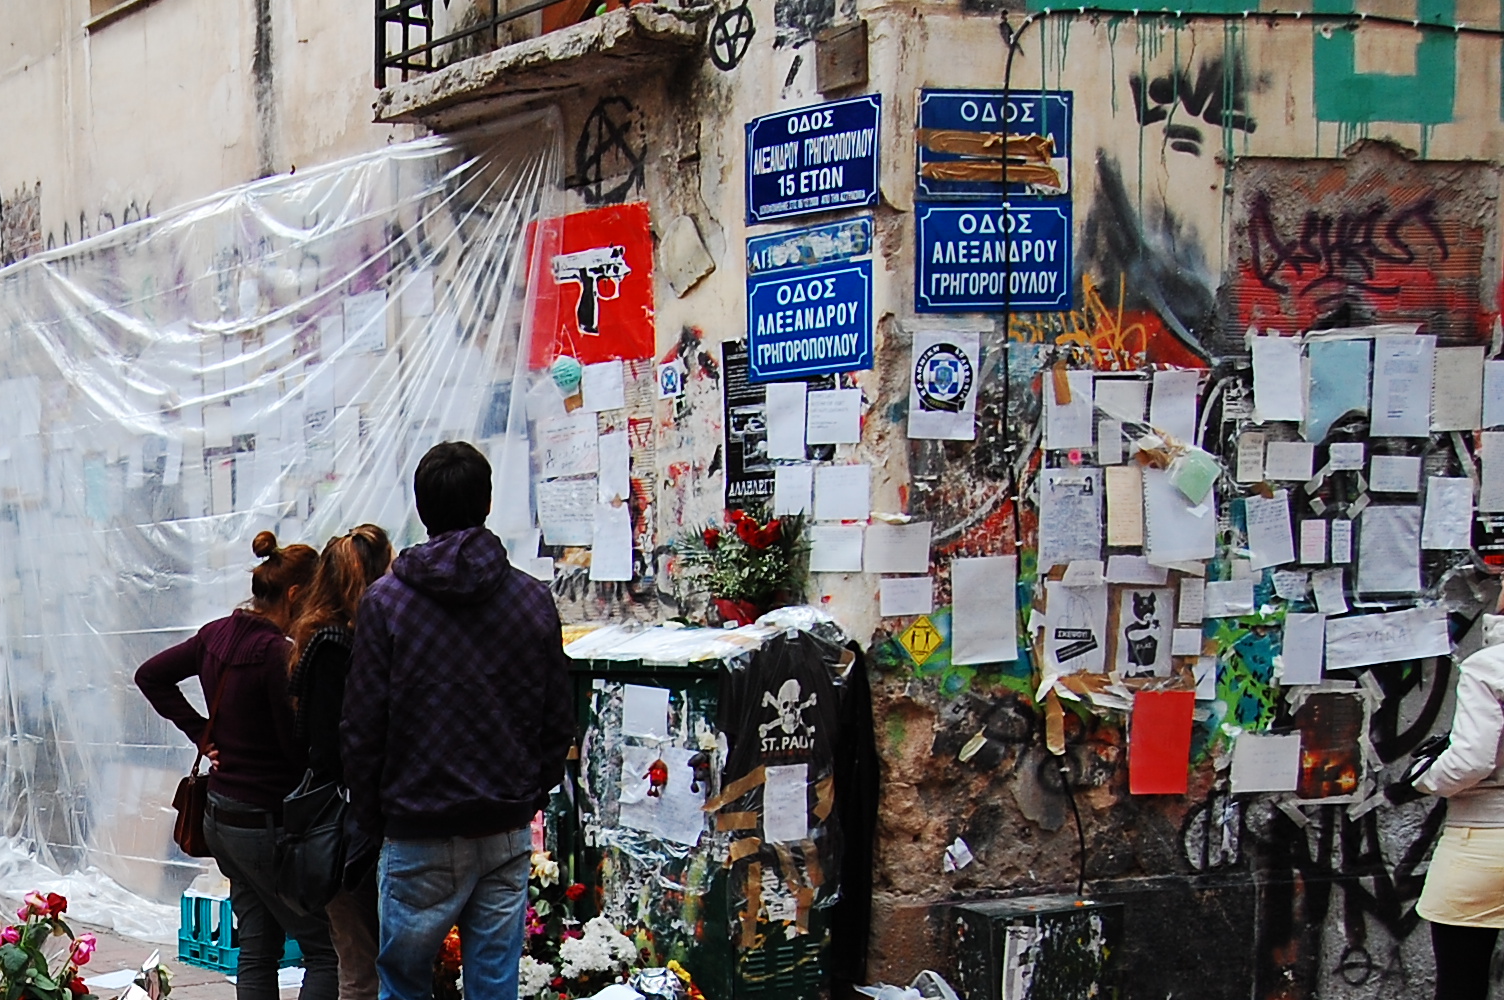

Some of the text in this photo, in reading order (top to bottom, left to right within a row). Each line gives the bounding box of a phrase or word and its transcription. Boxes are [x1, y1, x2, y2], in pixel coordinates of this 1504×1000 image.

[787, 109, 834, 135] ΟΔΟΣ
[960, 101, 1035, 122] ΟΔΟΣ
[804, 127, 874, 166] ΓΡΗΓΟΡΟΠΟΥΛΟΥ
[777, 165, 843, 197] 15 ΕΤΩΝ
[959, 213, 1032, 234] ΟΔΟΣ
[932, 239, 1057, 264] ΑΛΕΞΑΝΔΡΟΥ
[776, 278, 836, 305] ΟΔΟΣ
[757, 301, 858, 336] ΑΛΕΞΑΝΔΡΟΥ
[758, 332, 858, 366] ΓΡΗΓΟΡΟΠΟΥΛΟΥ
